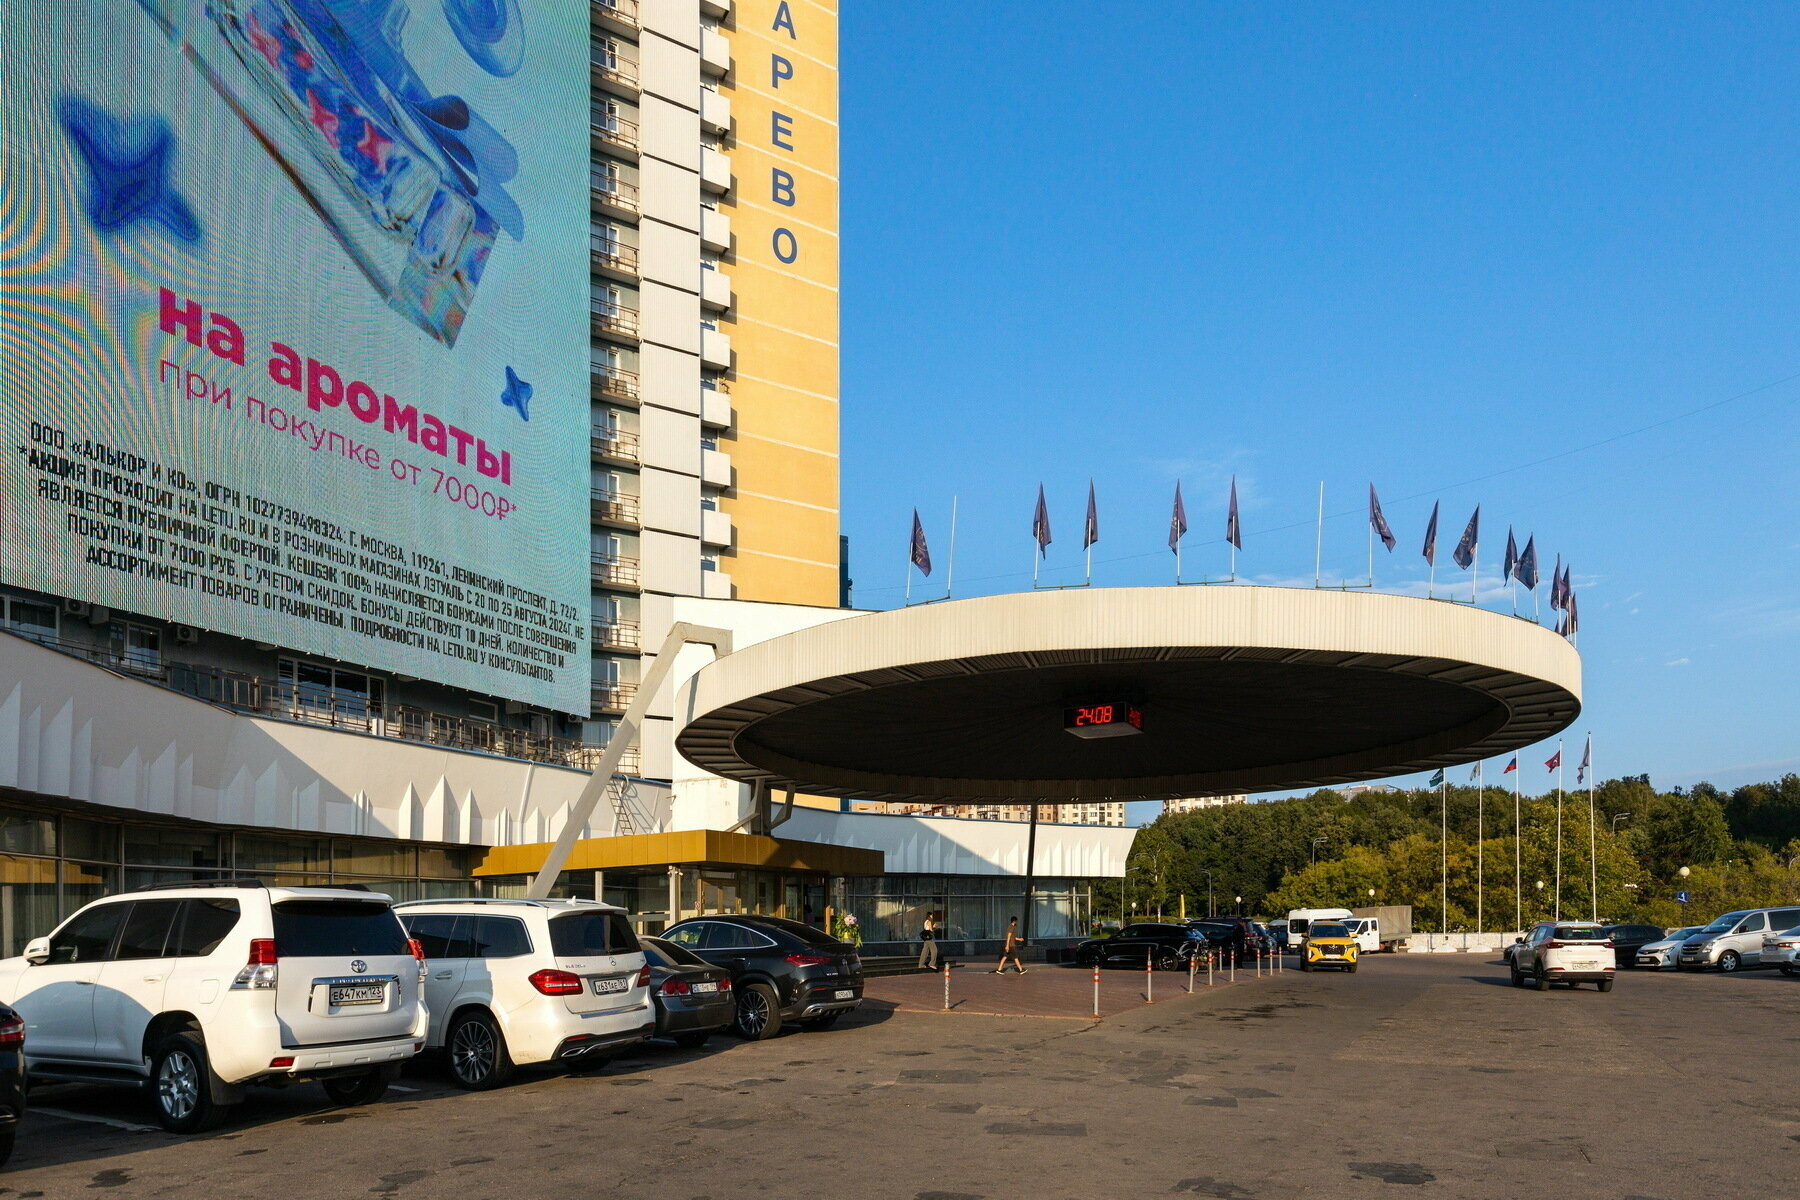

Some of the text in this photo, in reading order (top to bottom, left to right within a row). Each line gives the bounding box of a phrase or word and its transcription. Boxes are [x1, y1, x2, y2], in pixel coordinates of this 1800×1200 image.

[159, 285, 511, 486] на ароматы
[160, 359, 232, 410] при
[247, 396, 380, 470] покупке
[390, 458, 422, 484] от
[31, 422, 64, 450] ООО
[70, 440, 147, 478] «АЛЬКОР
[152, 462, 161, 481] И
[206, 481, 240, 508] ОГРН
[350, 530, 358, 548] Г.
[361, 534, 406, 566] МОСКВА,
[412, 552, 448, 580] 119261,
[452, 566, 504, 596] ЛЕНИНСКИЙ
[506, 584, 548, 613] ПРОСПЕКТ,
[38, 478, 577, 654] ЯВЛЯЕТСЯ ПУБЛИЧНОЙ ОФЕРТОЙ. КЕШБЭК 100% НАЧИСЛЯЕТСЯ БОНУСАМИ ПОСЛЕ СОВЕРШЕНИЯ
[68, 513, 144, 551] ПОКУПКИ
[149, 536, 165, 557] ОТ
[170, 542, 205, 568] 7000
[210, 554, 240, 578] РУБ.
[244, 564, 252, 581] С
[256, 566, 304, 596] УЧЕТОМ
[360, 596, 403, 624] БОНУСЫ
[406, 610, 462, 640] ДЕЙСТВУЮТ
[466, 628, 476, 644] 10
[478, 632, 504, 651] ДНЕЙ.
[506, 640, 556, 666] КОЛИЧЕСТВО
[558, 654, 564, 669] И
[91, 468, 174, 510] ПРОХОДИТ
[178, 496, 198, 518] НА
[260, 522, 268, 540] И
[272, 527, 281, 544] В
[284, 530, 356, 568] РОЗНИЧНЫХ
[360, 554, 421, 588] МАГАЗИНАХ
[424, 576, 464, 602] ЛЭТУАЛЬ
[466, 590, 473, 604] С
[475, 592, 485, 608] 20
[488, 596, 500, 613] ПО
[502, 602, 512, 616] 25
[514, 605, 548, 628] АВГУСТА
[576, 625, 585, 640] НЕ
[86, 545, 556, 684] АССОРТИМЕНТ ТОВАРОВ ОГРАНИЧЕНЫ. ПОДРОБНОСТИ НА LETU.RU У КОНСУЛЬТАНТОВ.
[1076, 705, 1112, 726] 24.08
